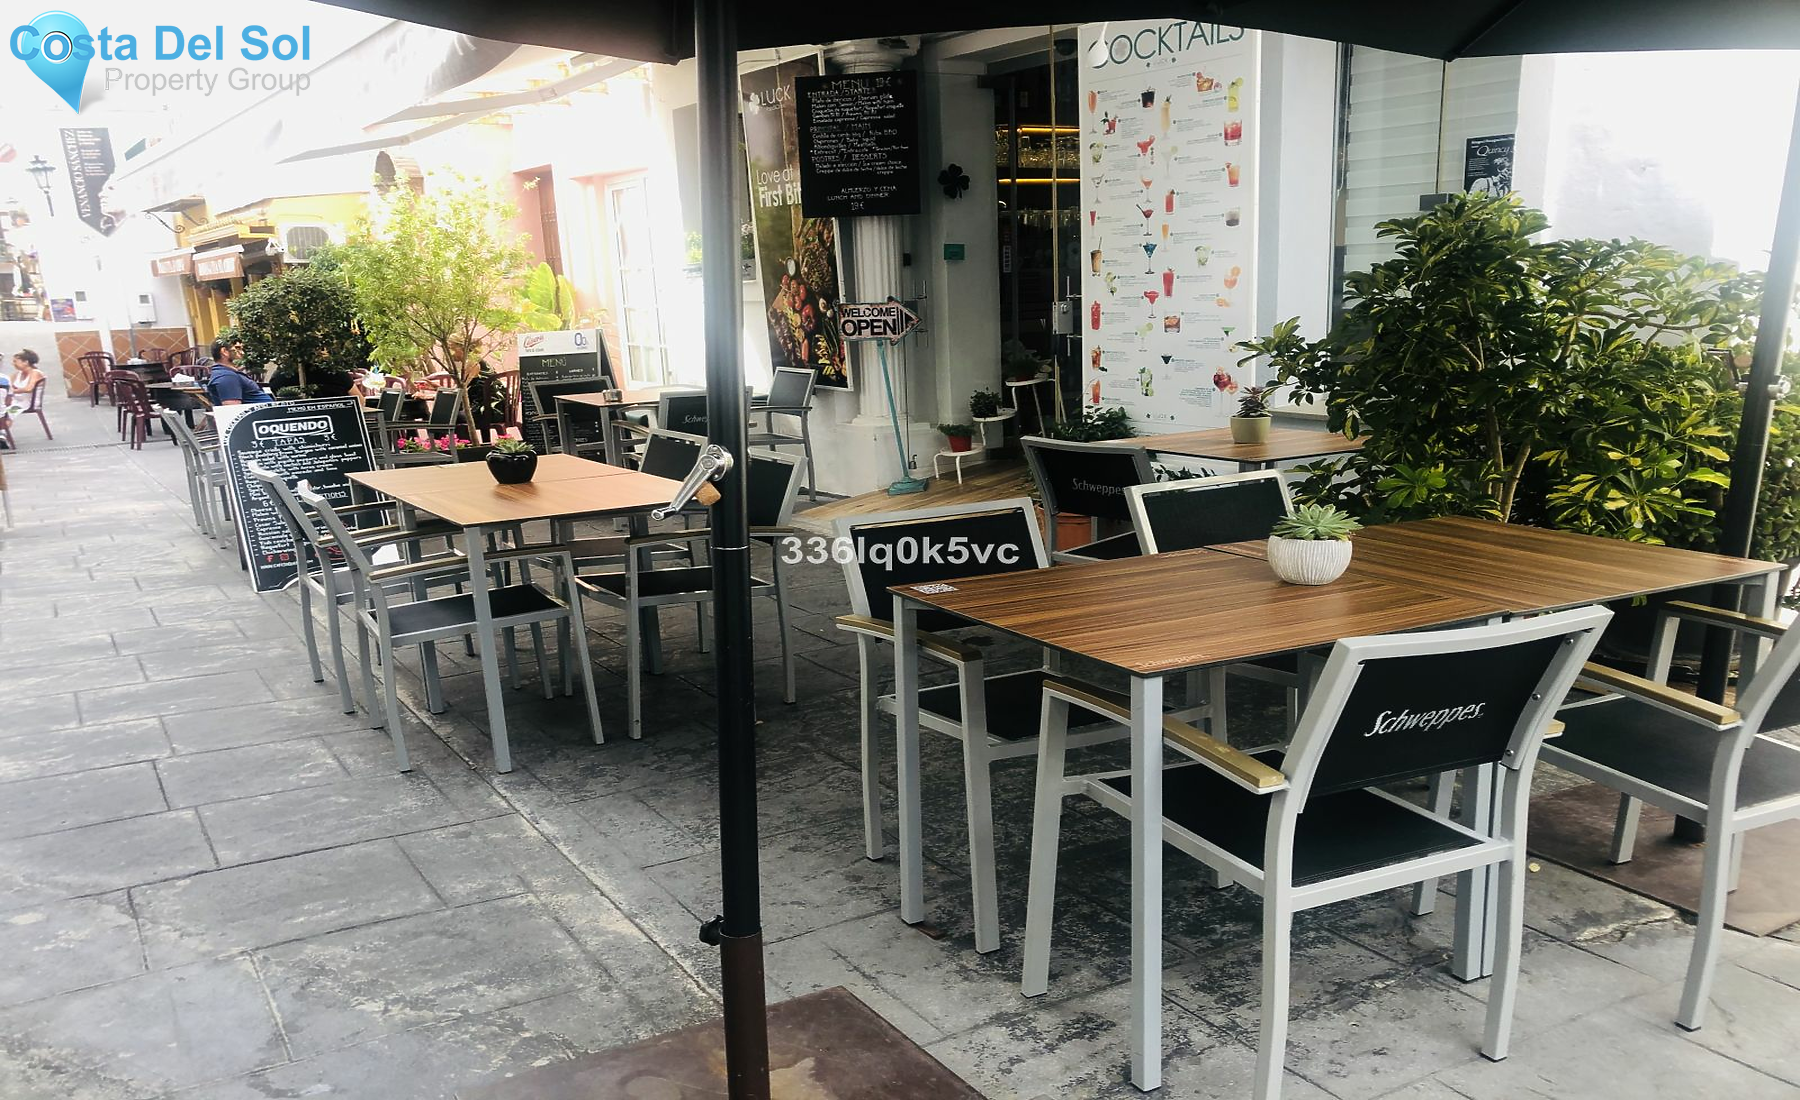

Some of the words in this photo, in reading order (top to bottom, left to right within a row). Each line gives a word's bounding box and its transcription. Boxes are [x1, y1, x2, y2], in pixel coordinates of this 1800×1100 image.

[760, 84, 791, 106] LUCK
[756, 169, 781, 185] Love
[782, 164, 794, 182] at
[758, 184, 783, 208] First
[841, 307, 896, 318] WELCOME
[258, 420, 329, 435] OQUENDO
[272, 437, 307, 447] TAPAS
[1363, 702, 1486, 737] Schweppes
